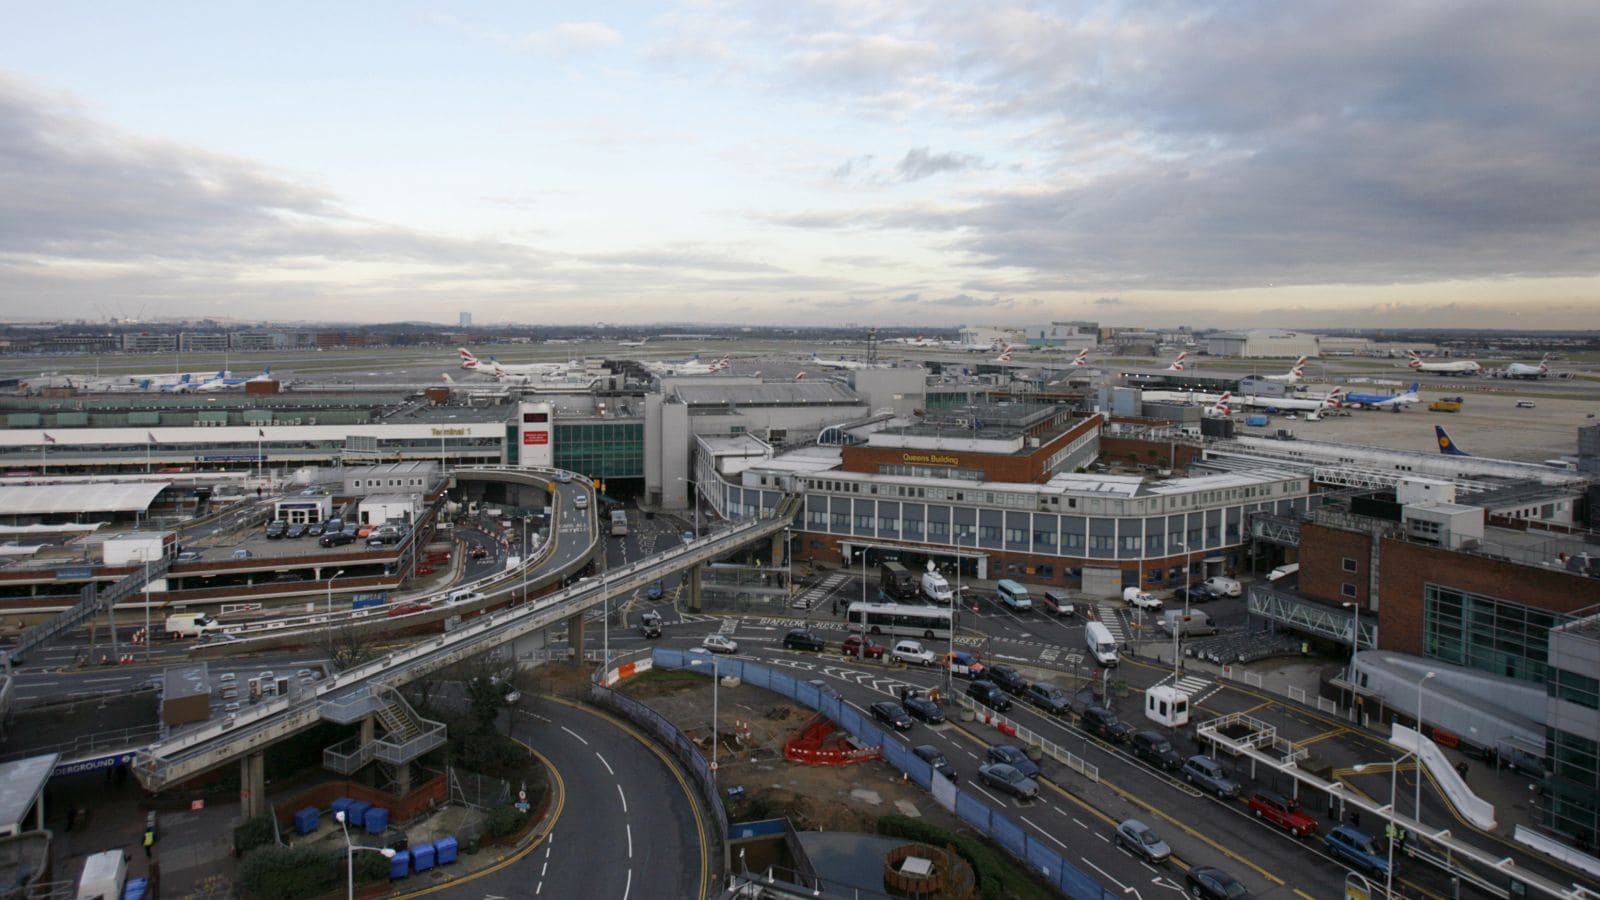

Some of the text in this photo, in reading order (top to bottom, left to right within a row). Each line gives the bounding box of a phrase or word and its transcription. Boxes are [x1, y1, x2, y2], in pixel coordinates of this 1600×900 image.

[431, 427, 472, 436] Terminal 1
[903, 453, 960, 465] Queens Building
[52, 758, 115, 776] DERGROUND
